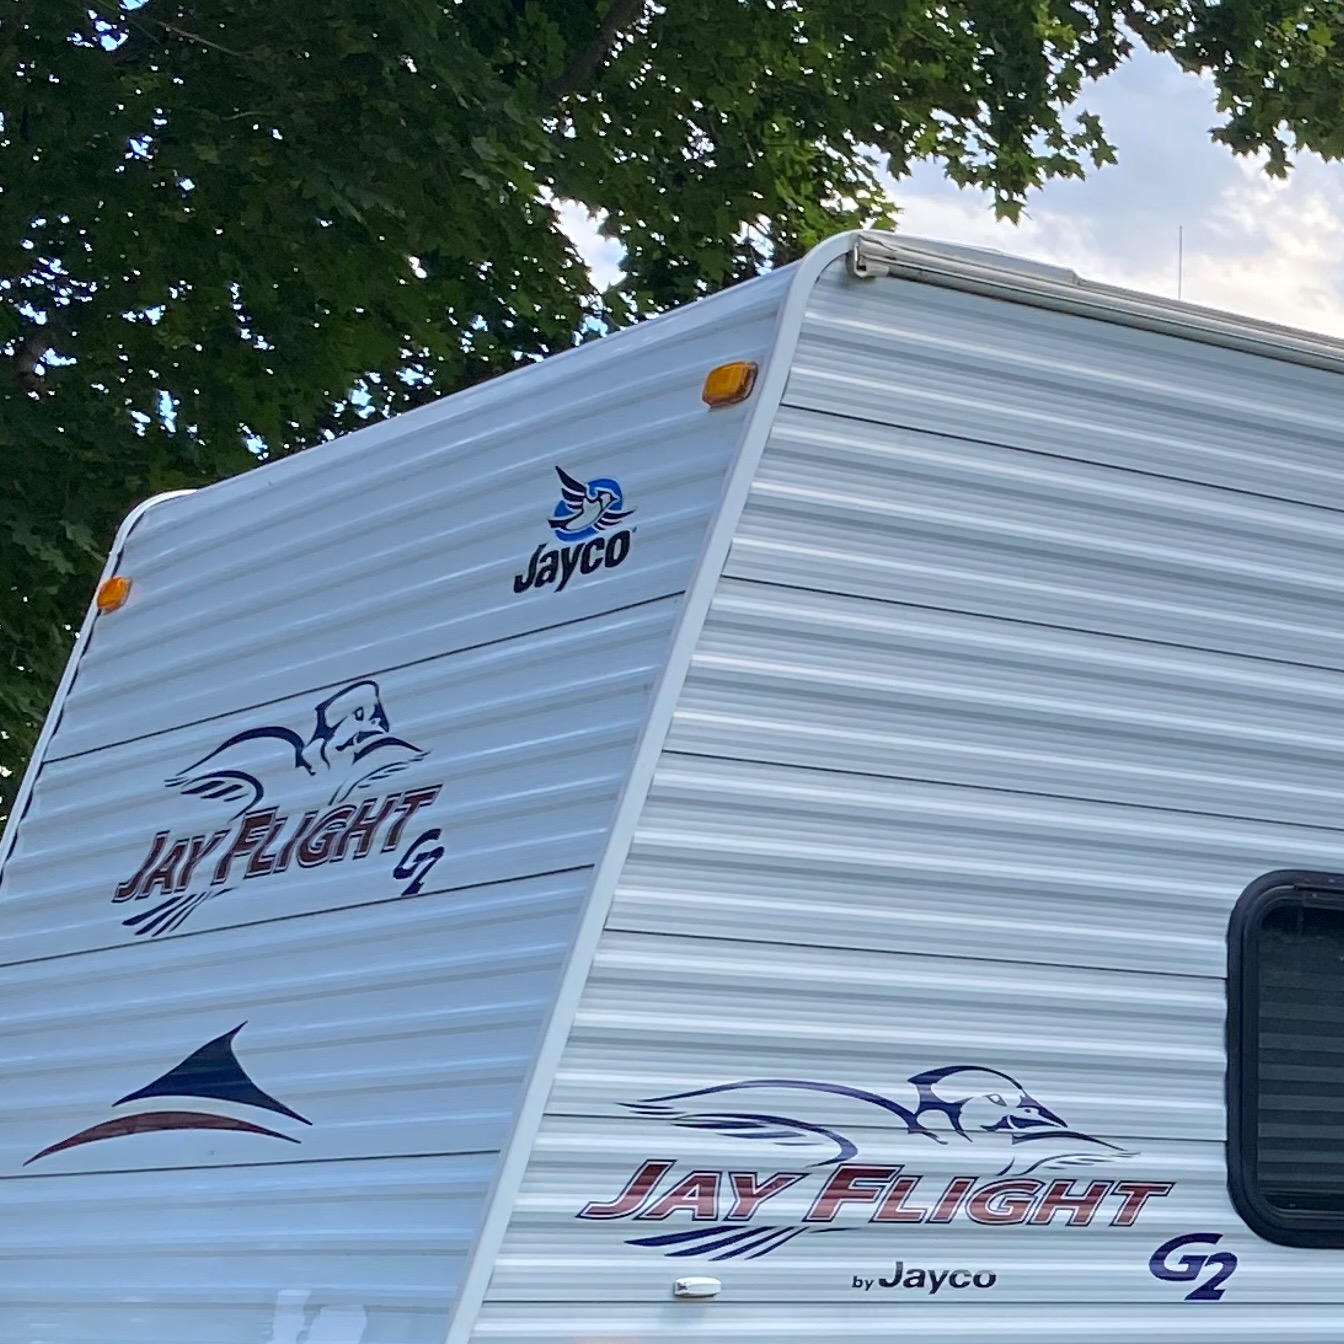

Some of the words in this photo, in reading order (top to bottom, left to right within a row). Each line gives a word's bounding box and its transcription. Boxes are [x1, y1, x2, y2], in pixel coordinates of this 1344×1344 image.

[513, 530, 631, 594] Jayco
[111, 829, 231, 903] JAY
[210, 784, 443, 885] FLIGHT
[393, 828, 445, 897] G2
[575, 1159, 812, 1222] JAY
[801, 1163, 1176, 1228] FLIGHT
[851, 1275, 875, 1291] by
[878, 1260, 997, 1294] Jayco
[1148, 1232, 1238, 1301] G2
